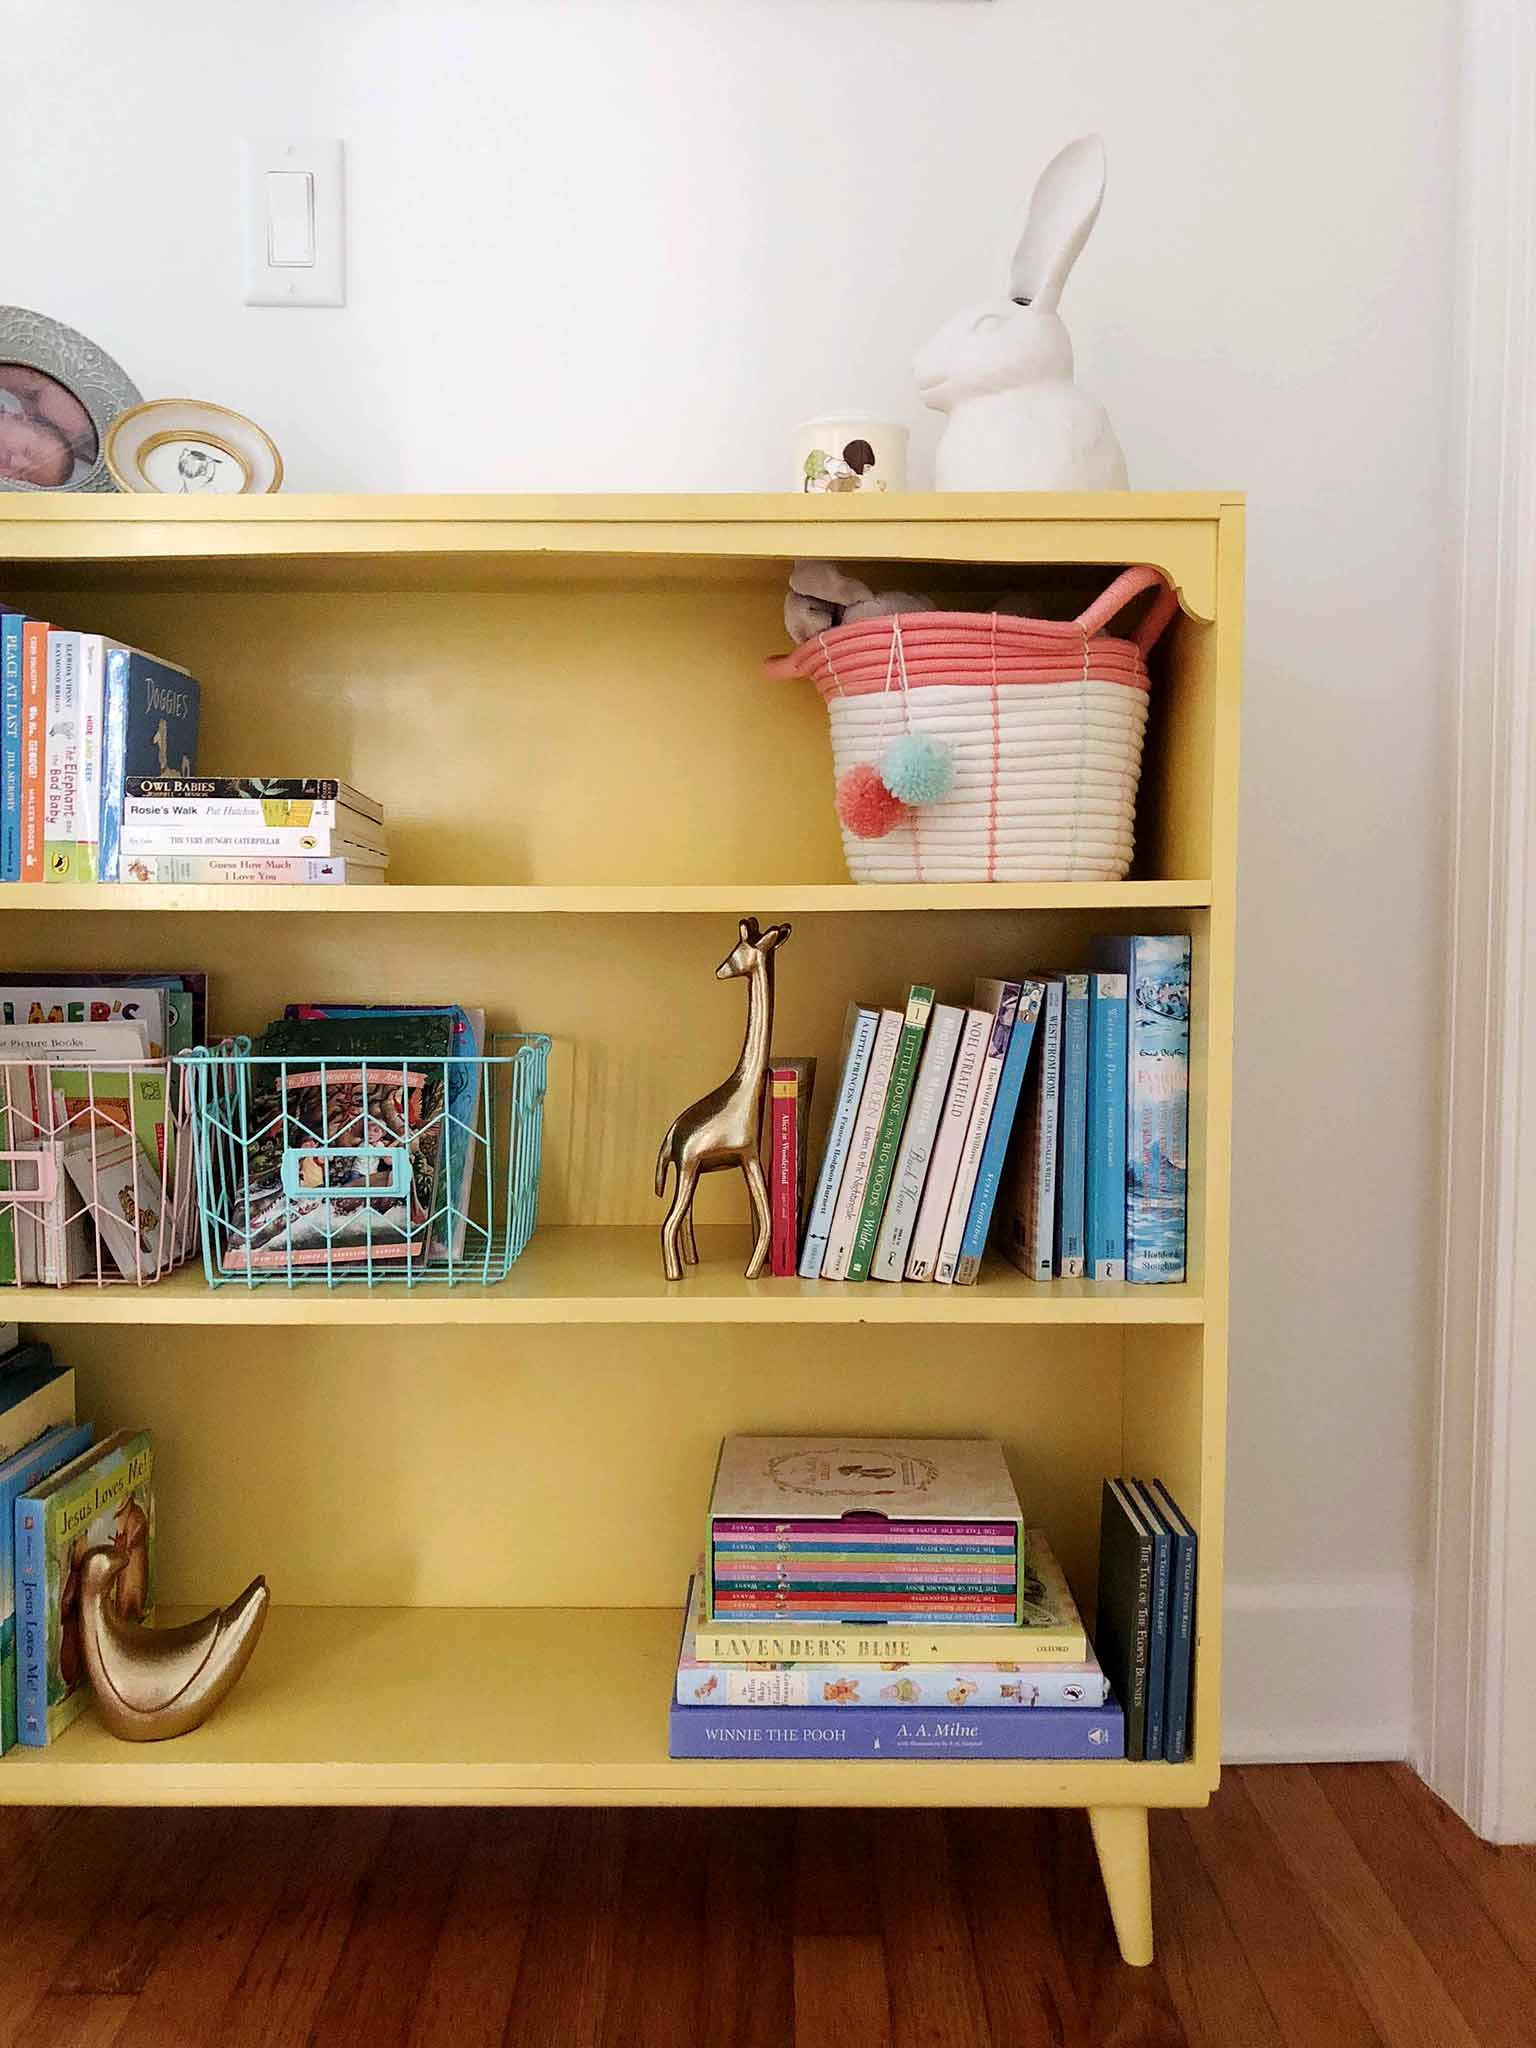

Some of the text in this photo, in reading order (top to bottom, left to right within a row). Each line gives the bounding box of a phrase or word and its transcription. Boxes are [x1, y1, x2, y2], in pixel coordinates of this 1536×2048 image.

[7, 634, 16, 736] PEACE AT LAST
[145, 678, 188, 719] DOGGIES
[65, 745, 75, 760] The
[6, 750, 15, 812] JILL MURPHY
[49, 768, 60, 789] Bad
[61, 764, 76, 816] Elephant
[141, 781, 215, 792] OWL BABIES
[46, 794, 60, 823] Baby
[131, 805, 197, 815] Rosie's Walk
[234, 837, 280, 845] CATERPILLAR
[209, 860, 291, 869] Guess How Much
[225, 872, 276, 880] I Love You
[10, 1039, 47, 1048] Picture
[51, 1037, 83, 1048] Books
[1047, 1015, 1057, 1041] WEST
[844, 1021, 869, 1104] A LITTLE PRINCESS
[1046, 1043, 1056, 1070] FROM
[1105, 1008, 1118, 1091] Watership Down
[865, 1018, 898, 1118] RUMER GODDEN
[949, 1020, 983, 1118] NOEL STREATFEILD
[1045, 1071, 1055, 1099] HOME
[780, 1114, 788, 1130] Alice
[868, 1032, 916, 1206] LITTLE HOUSE in the BIG WOODS
[967, 1065, 997, 1165] The Wind in the Willows
[1045, 1109, 1053, 1133] LAURA
[780, 1142, 788, 1184] Wonderland
[819, 1115, 848, 1214] Frances Hodgson Burnett
[1044, 1135, 1052, 1165] INGALLS
[841, 1125, 875, 1220] Listen to the Nightingale
[981, 1172, 993, 1199] SUSAN
[894, 1181, 920, 1217] Home
[857, 1216, 874, 1250] Wilder
[60, 1449, 150, 1536] Jesus Loves Me!
[22, 1580, 37, 1691] Jesus Loves Me!
[1133, 1544, 1151, 1707] THE TALE OF THE FLOPSY BUNNIES
[714, 1639, 911, 1657] LAVENDER'S BLUE
[748, 1678, 756, 1703] Puffin
[758, 1681, 766, 1701] Baby
[705, 1728, 846, 1742] WINNIE THE POOH
[897, 1723, 978, 1737] A. A. Milne
